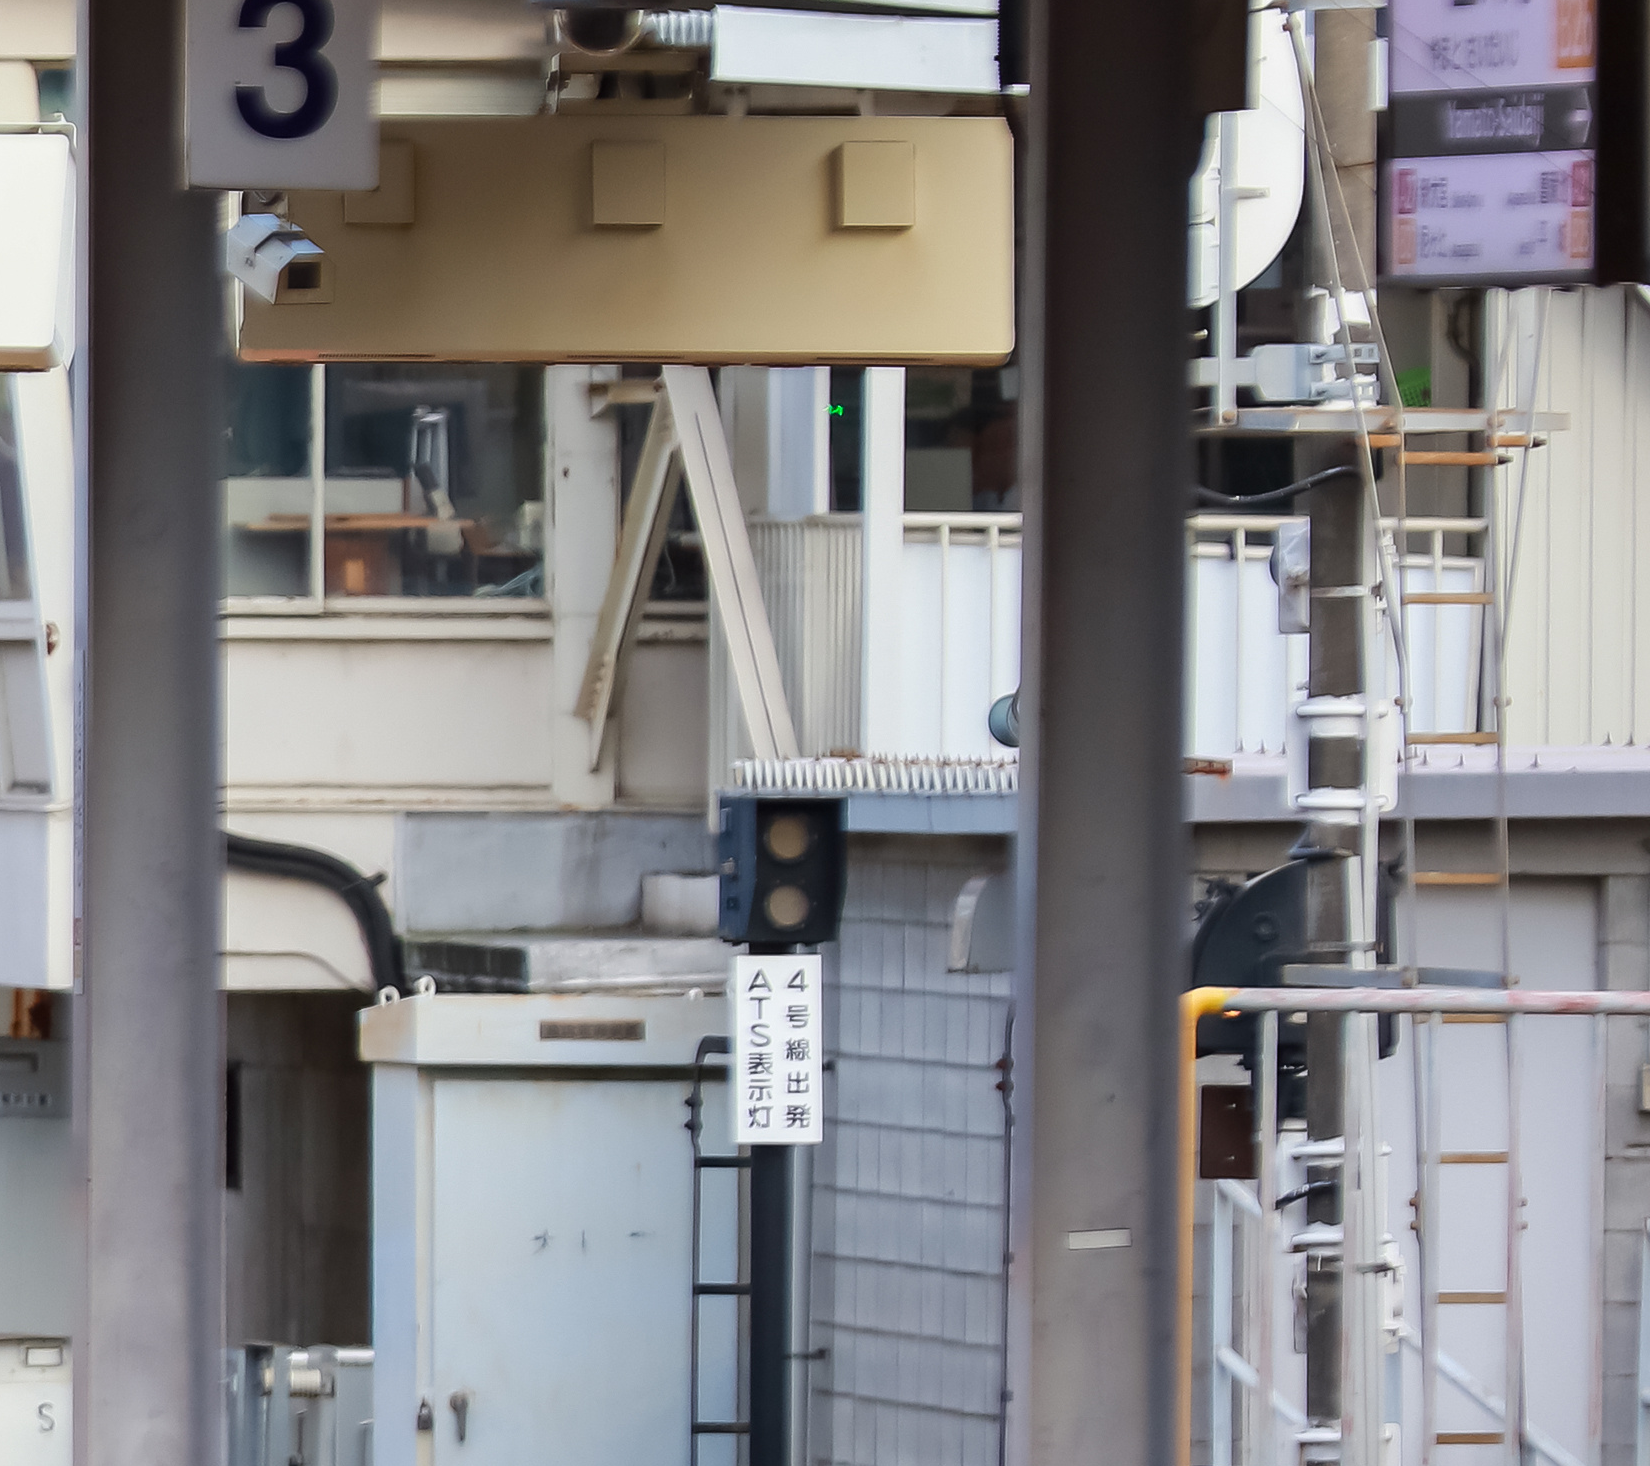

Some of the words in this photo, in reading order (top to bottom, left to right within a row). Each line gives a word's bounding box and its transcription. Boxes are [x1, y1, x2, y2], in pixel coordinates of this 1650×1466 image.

[748, 967, 774, 1129] ATS表示灯
[785, 967, 811, 1129] 4号線出発
